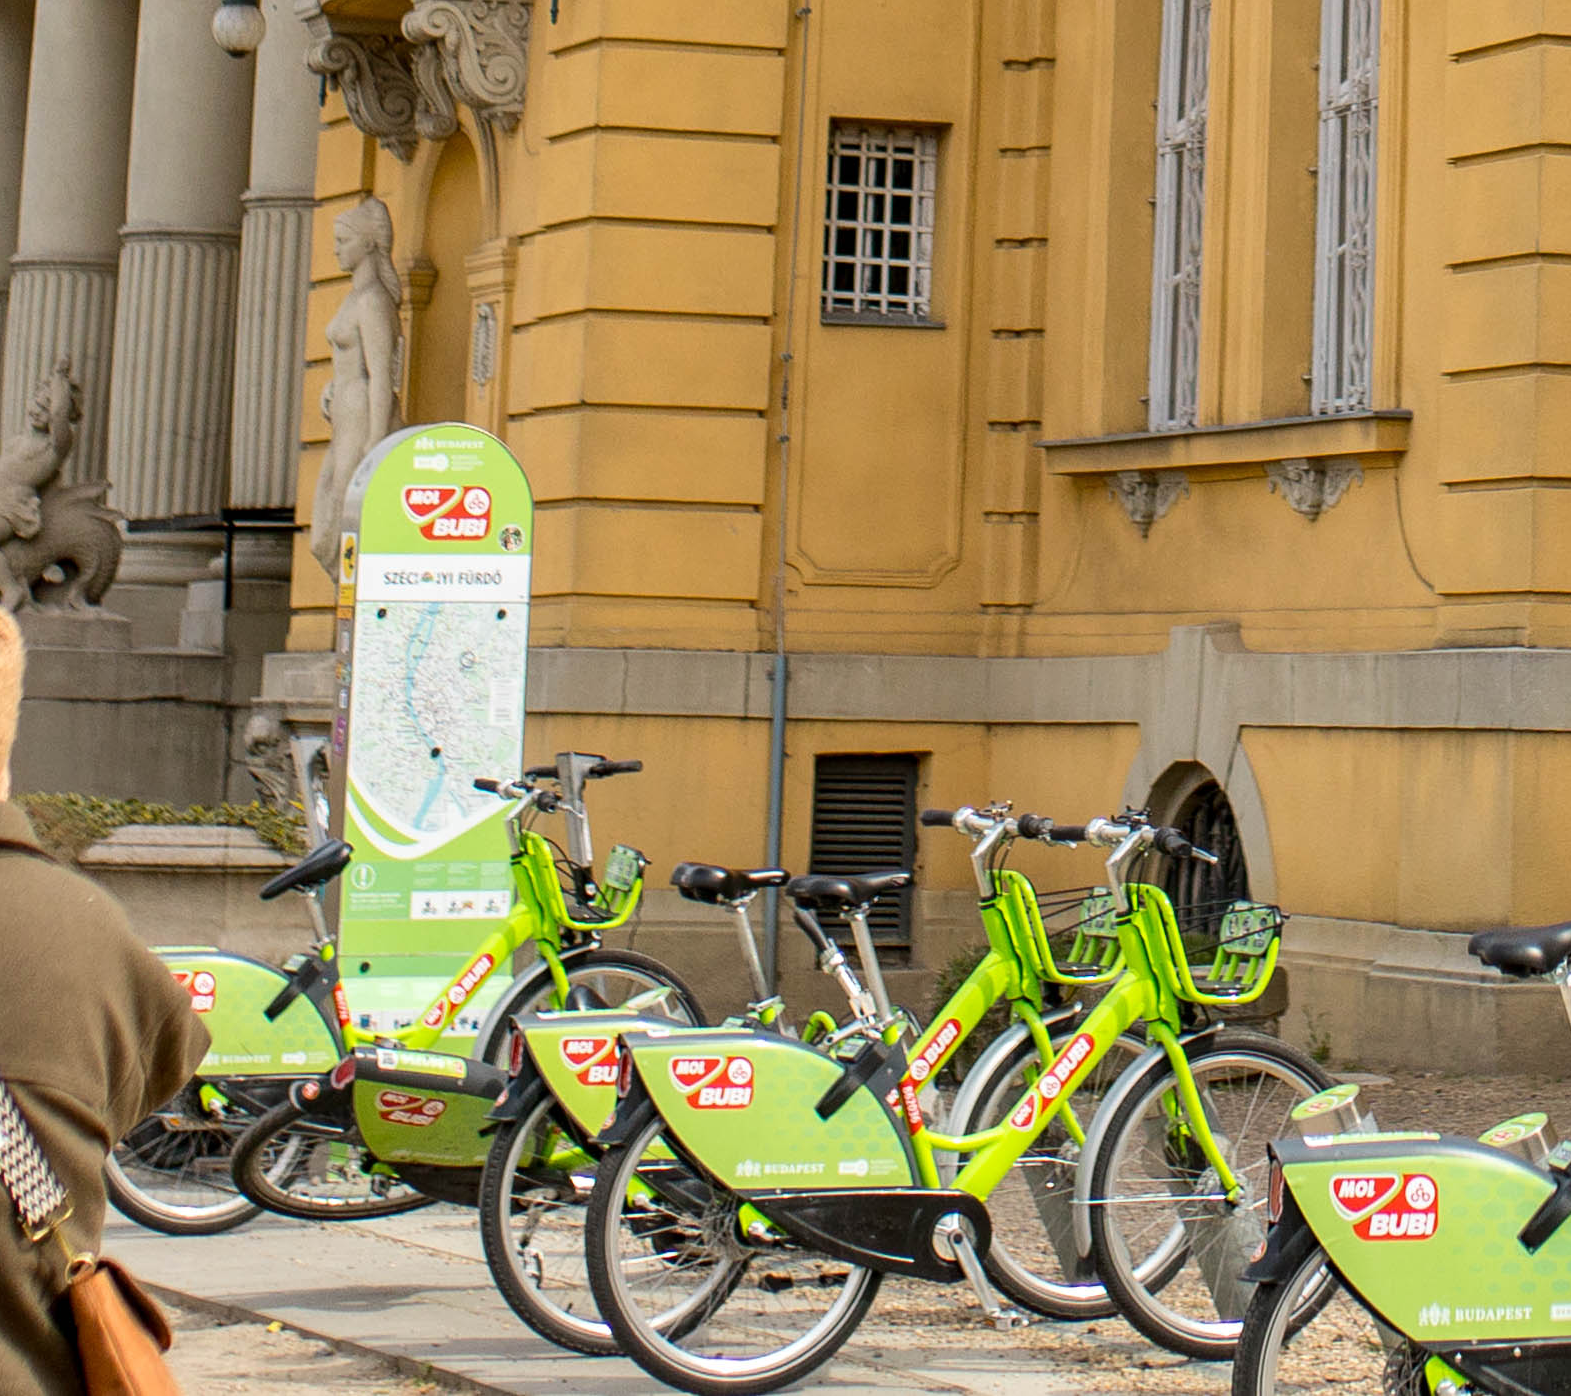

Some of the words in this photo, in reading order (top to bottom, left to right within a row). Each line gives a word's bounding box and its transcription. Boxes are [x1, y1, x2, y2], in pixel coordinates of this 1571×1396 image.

[409, 491, 440, 505] MOL
[432, 518, 487, 537] BUBI
[566, 1041, 595, 1054] MOL
[924, 1022, 958, 1065] BUBI
[675, 1061, 705, 1075] MOL
[1054, 1037, 1092, 1082] BUBI
[587, 1065, 619, 1083] BU
[698, 1087, 752, 1106] BUBI
[764, 1162, 826, 1175] BUDAPEST
[1338, 1179, 1376, 1198] MOL
[1369, 1212, 1436, 1237] BUBI
[1455, 1305, 1533, 1322] BUDAPEST
